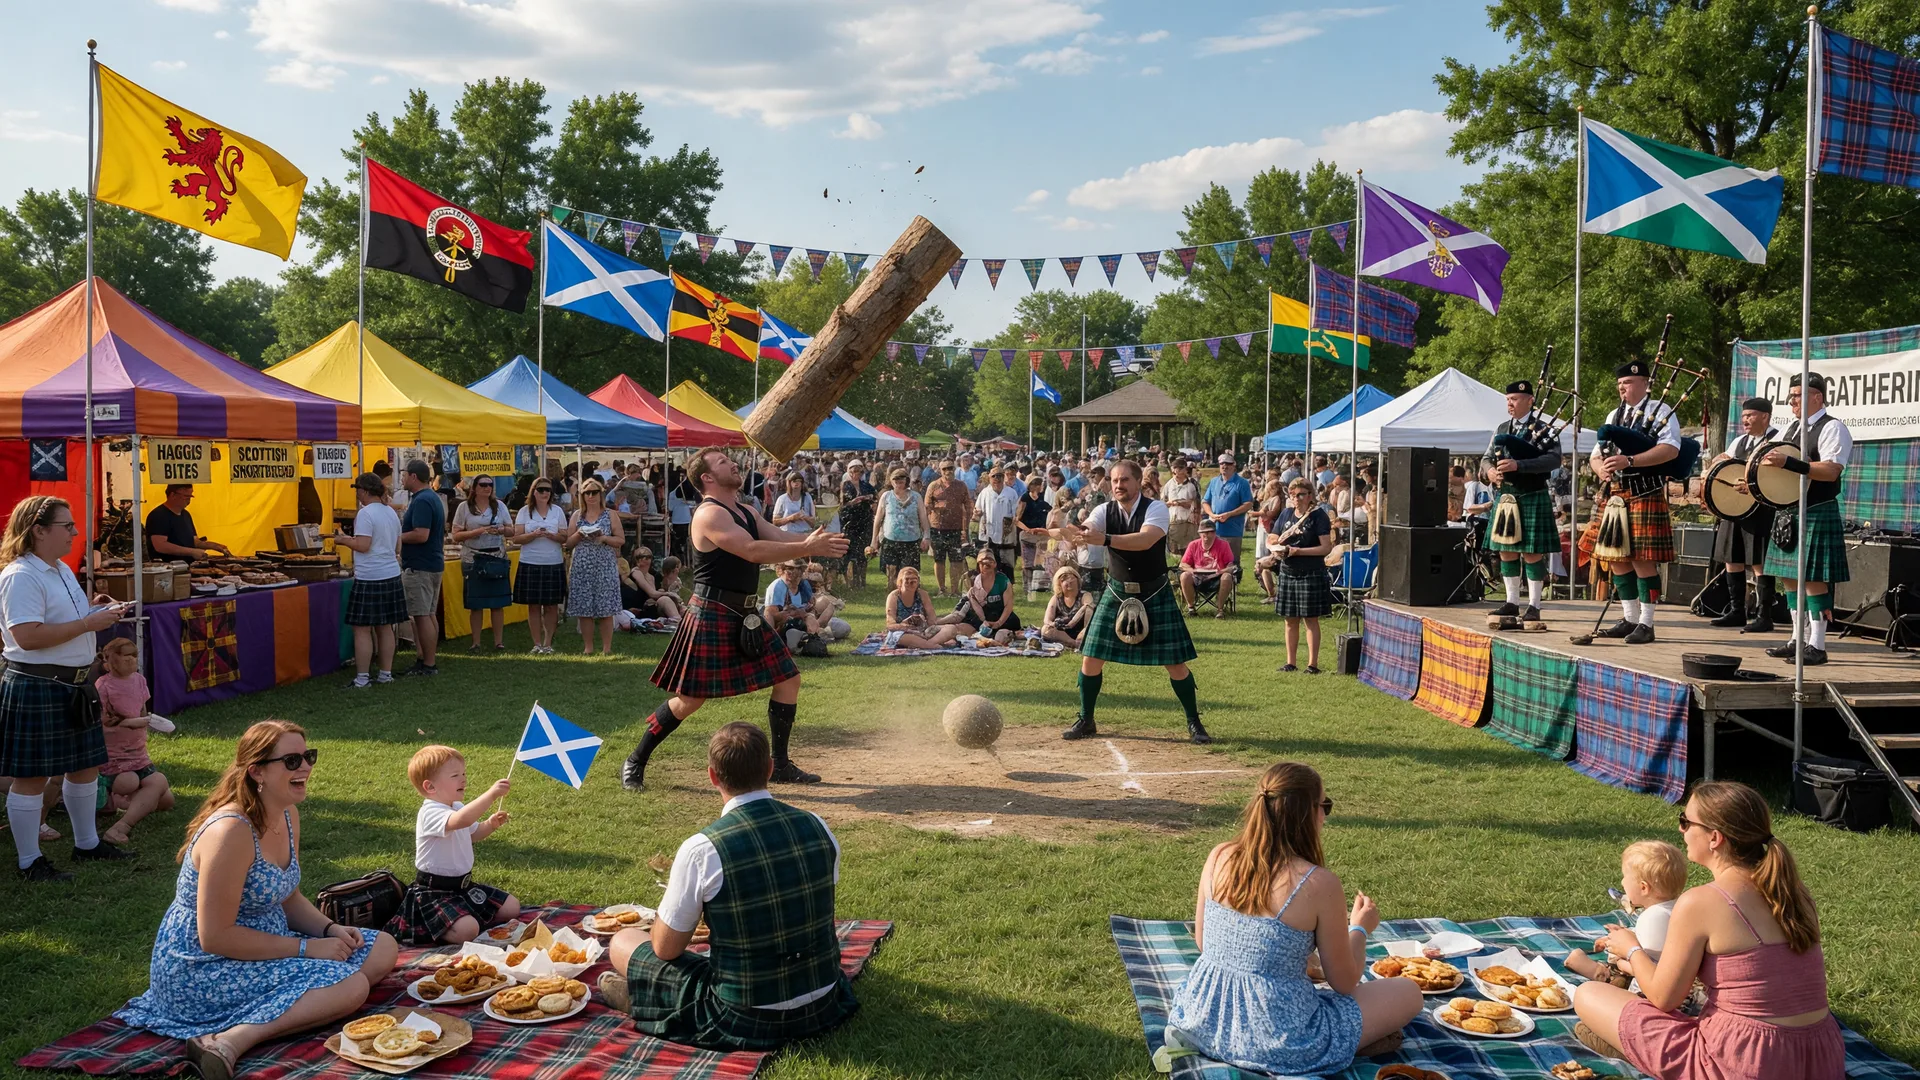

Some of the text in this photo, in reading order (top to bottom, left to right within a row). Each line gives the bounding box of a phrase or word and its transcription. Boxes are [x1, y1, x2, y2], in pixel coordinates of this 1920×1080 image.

[157, 444, 202, 460] HAGGIS
[238, 446, 287, 462] SCOTTISH
[164, 463, 199, 479] BITES
